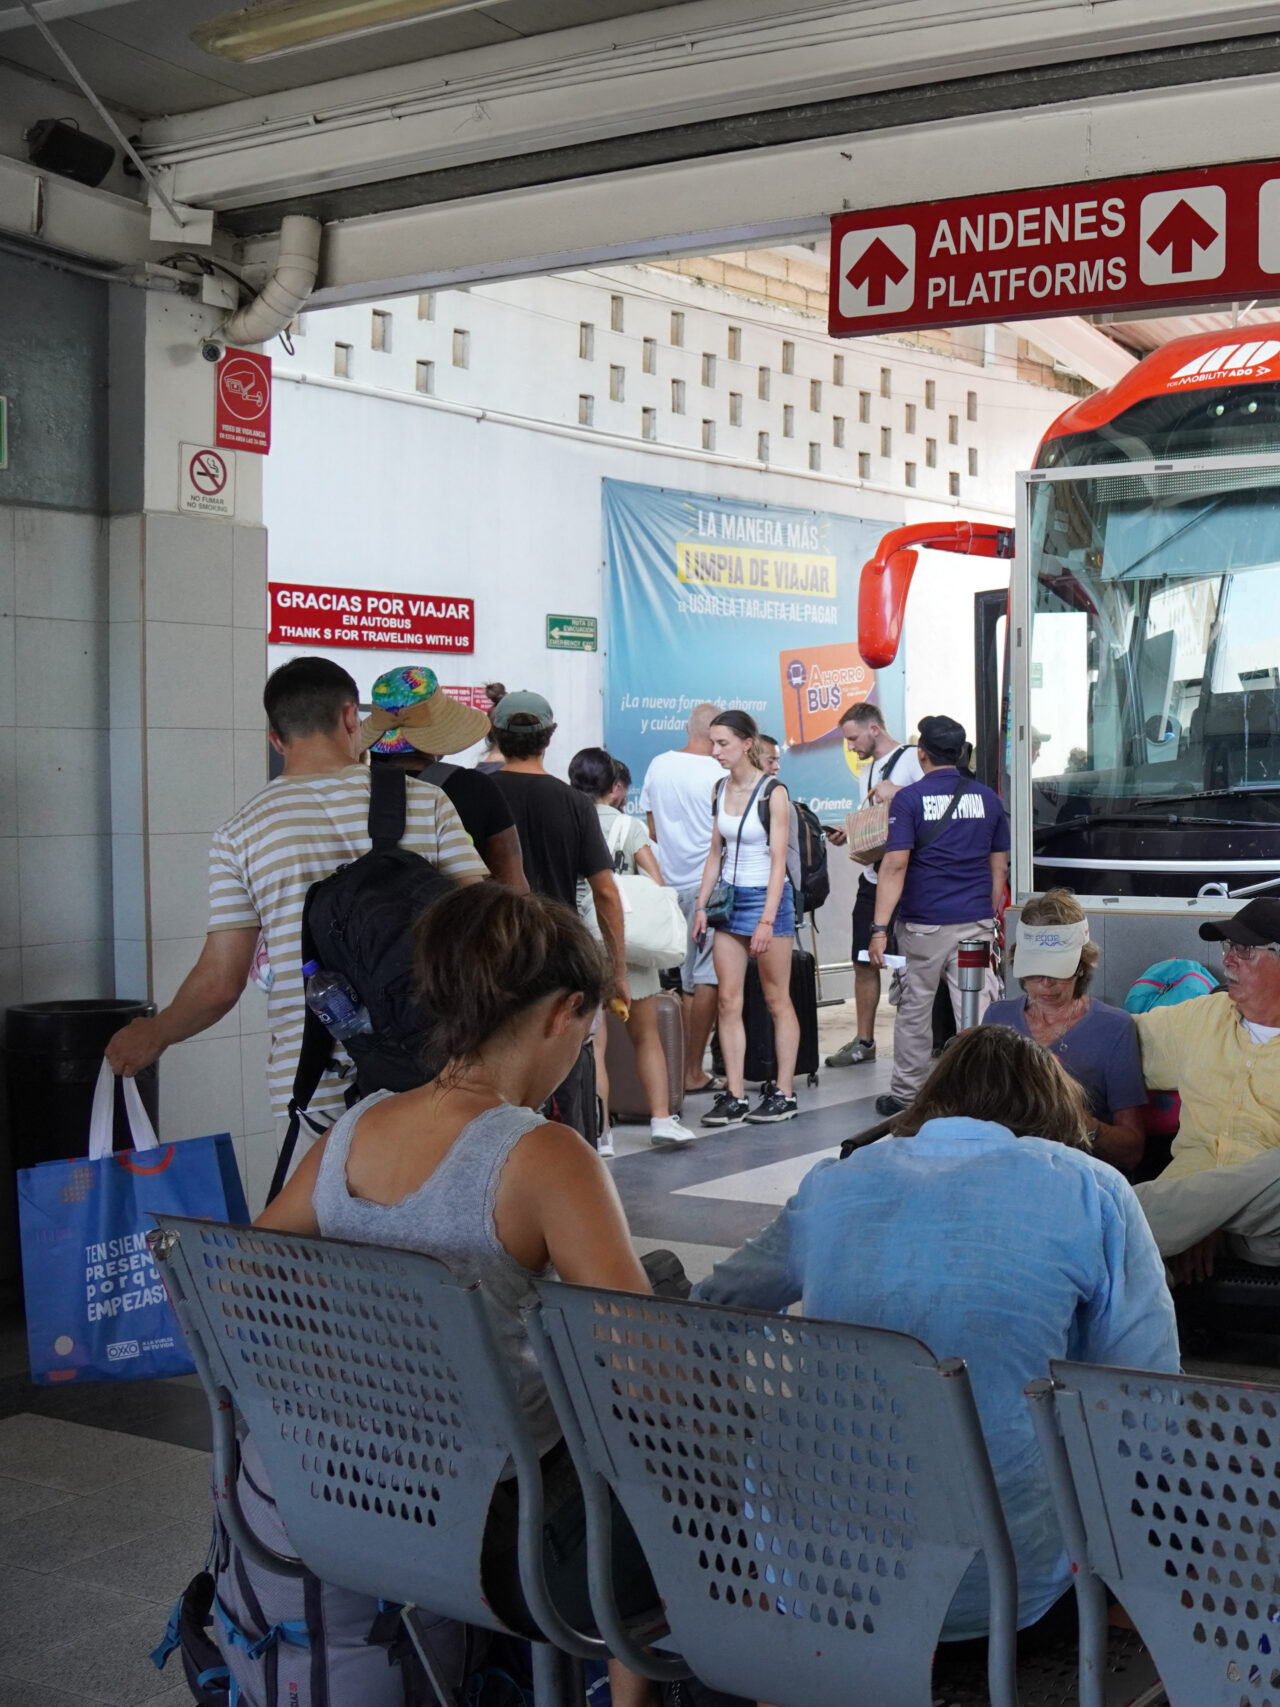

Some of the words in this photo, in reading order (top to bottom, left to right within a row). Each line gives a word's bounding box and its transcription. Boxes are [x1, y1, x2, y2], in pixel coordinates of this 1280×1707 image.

[929, 197, 1126, 258] ANDENES
[927, 256, 1127, 310] PLATFORMS
[1178, 370, 1229, 385] MOBILITY
[1229, 368, 1253, 377] ADO
[222, 424, 235, 432] VIDEO
[236, 426, 241, 434] DE
[242, 428, 266, 438] VIGILANCIA
[198, 502, 228, 512] SMOKING
[202, 496, 224, 505] FUMAR
[698, 510, 717, 538] LA
[721, 513, 783, 546] MANERA
[787, 519, 819, 550] MÁS
[685, 550, 744, 585] LIMPIA
[749, 558, 770, 587] DE
[773, 560, 830, 593] VIAJAR
[276, 590, 362, 612] GRACIAS
[366, 596, 404, 615] POR
[408, 600, 470, 620] VIAJAR
[688, 594, 719, 615] USAR
[720, 597, 736, 617] LA
[740, 598, 786, 620] TARJETA
[789, 602, 802, 622] AL
[804, 604, 838, 624] PAGAR
[342, 614, 358, 626] EN
[360, 616, 412, 628] AUTOBUS
[334, 629, 359, 641] FOR
[361, 630, 423, 644] TRAVELING
[425, 634, 452, 646] WITH
[454, 636, 470, 647] US
[642, 698, 676, 709] nueva
[714, 696, 727, 710] de
[728, 697, 768, 712] ahorrar
[640, 718, 648, 734] y
[810, 797, 854, 812] Oriente
[85, 1242, 108, 1265] TEN
[86, 1252, 154, 1282] PRESEN
[86, 1268, 161, 1302] porqu
[87, 1284, 168, 1322] EMPEZAST
[108, 1342, 139, 1360] OXXO
